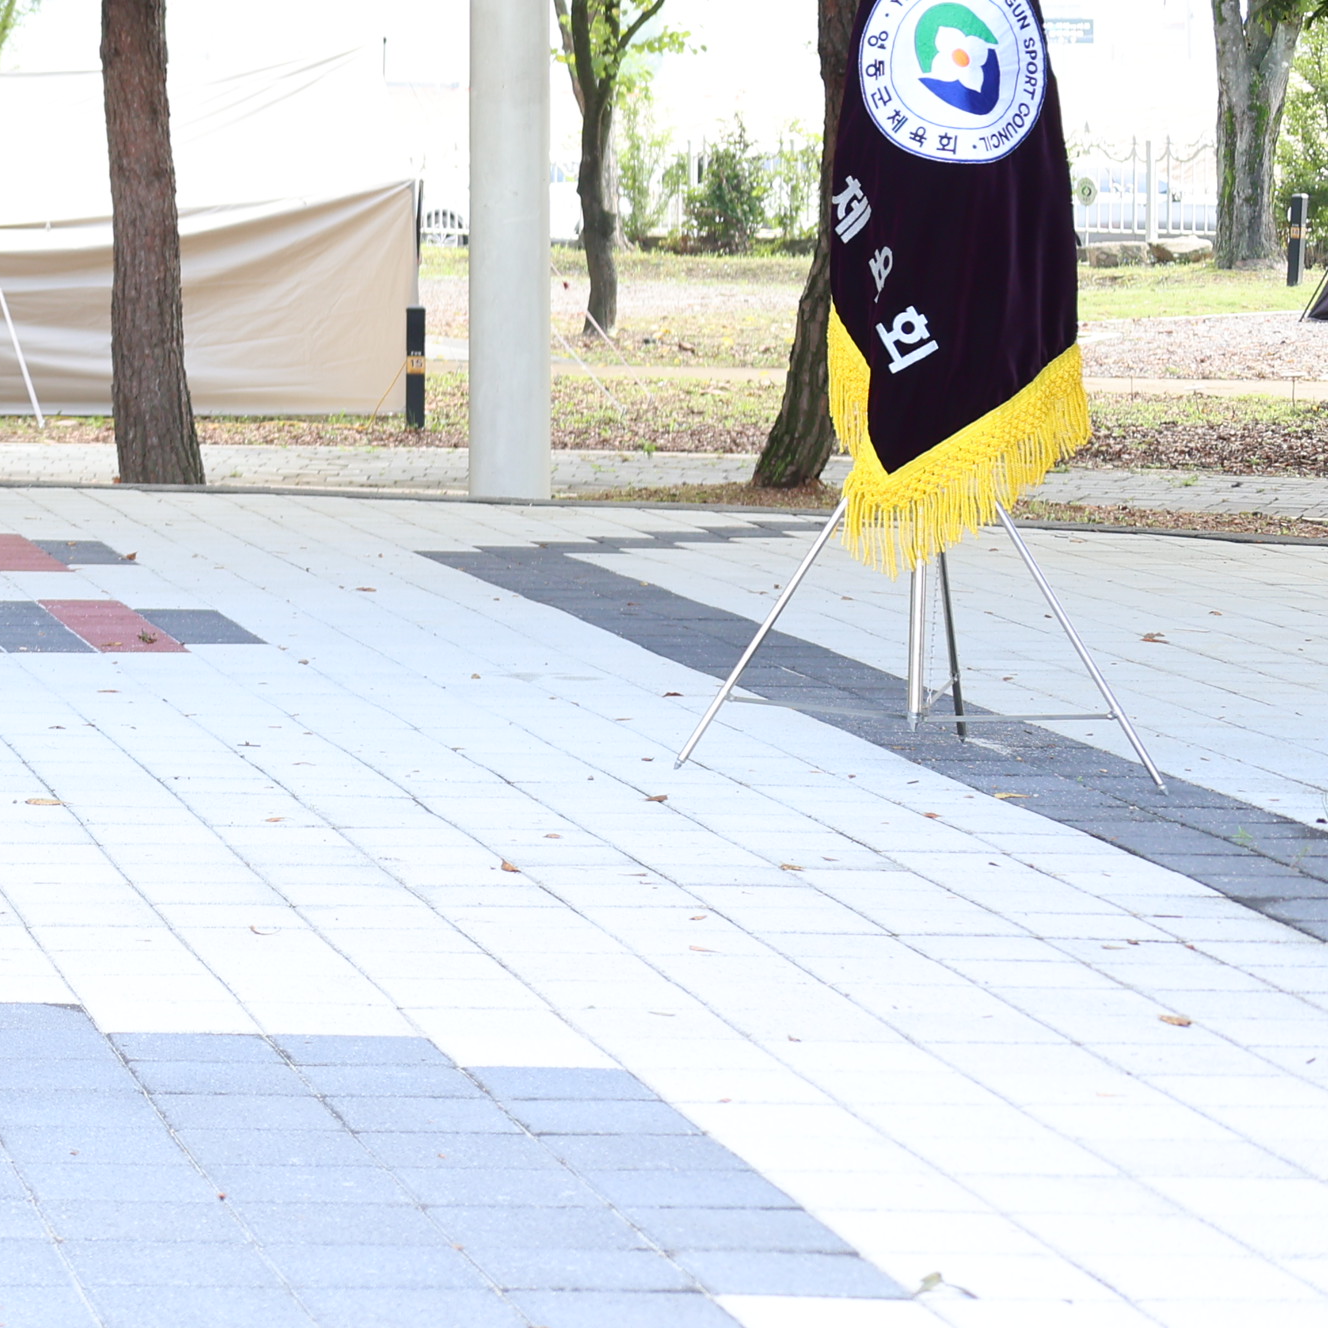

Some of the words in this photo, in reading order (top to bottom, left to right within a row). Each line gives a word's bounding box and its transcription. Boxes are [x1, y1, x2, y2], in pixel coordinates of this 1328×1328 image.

[866, 30, 958, 155] 영동군체육회
[1023, 37, 1038, 100] SPORT
[979, 102, 1030, 152] COUNCIL
